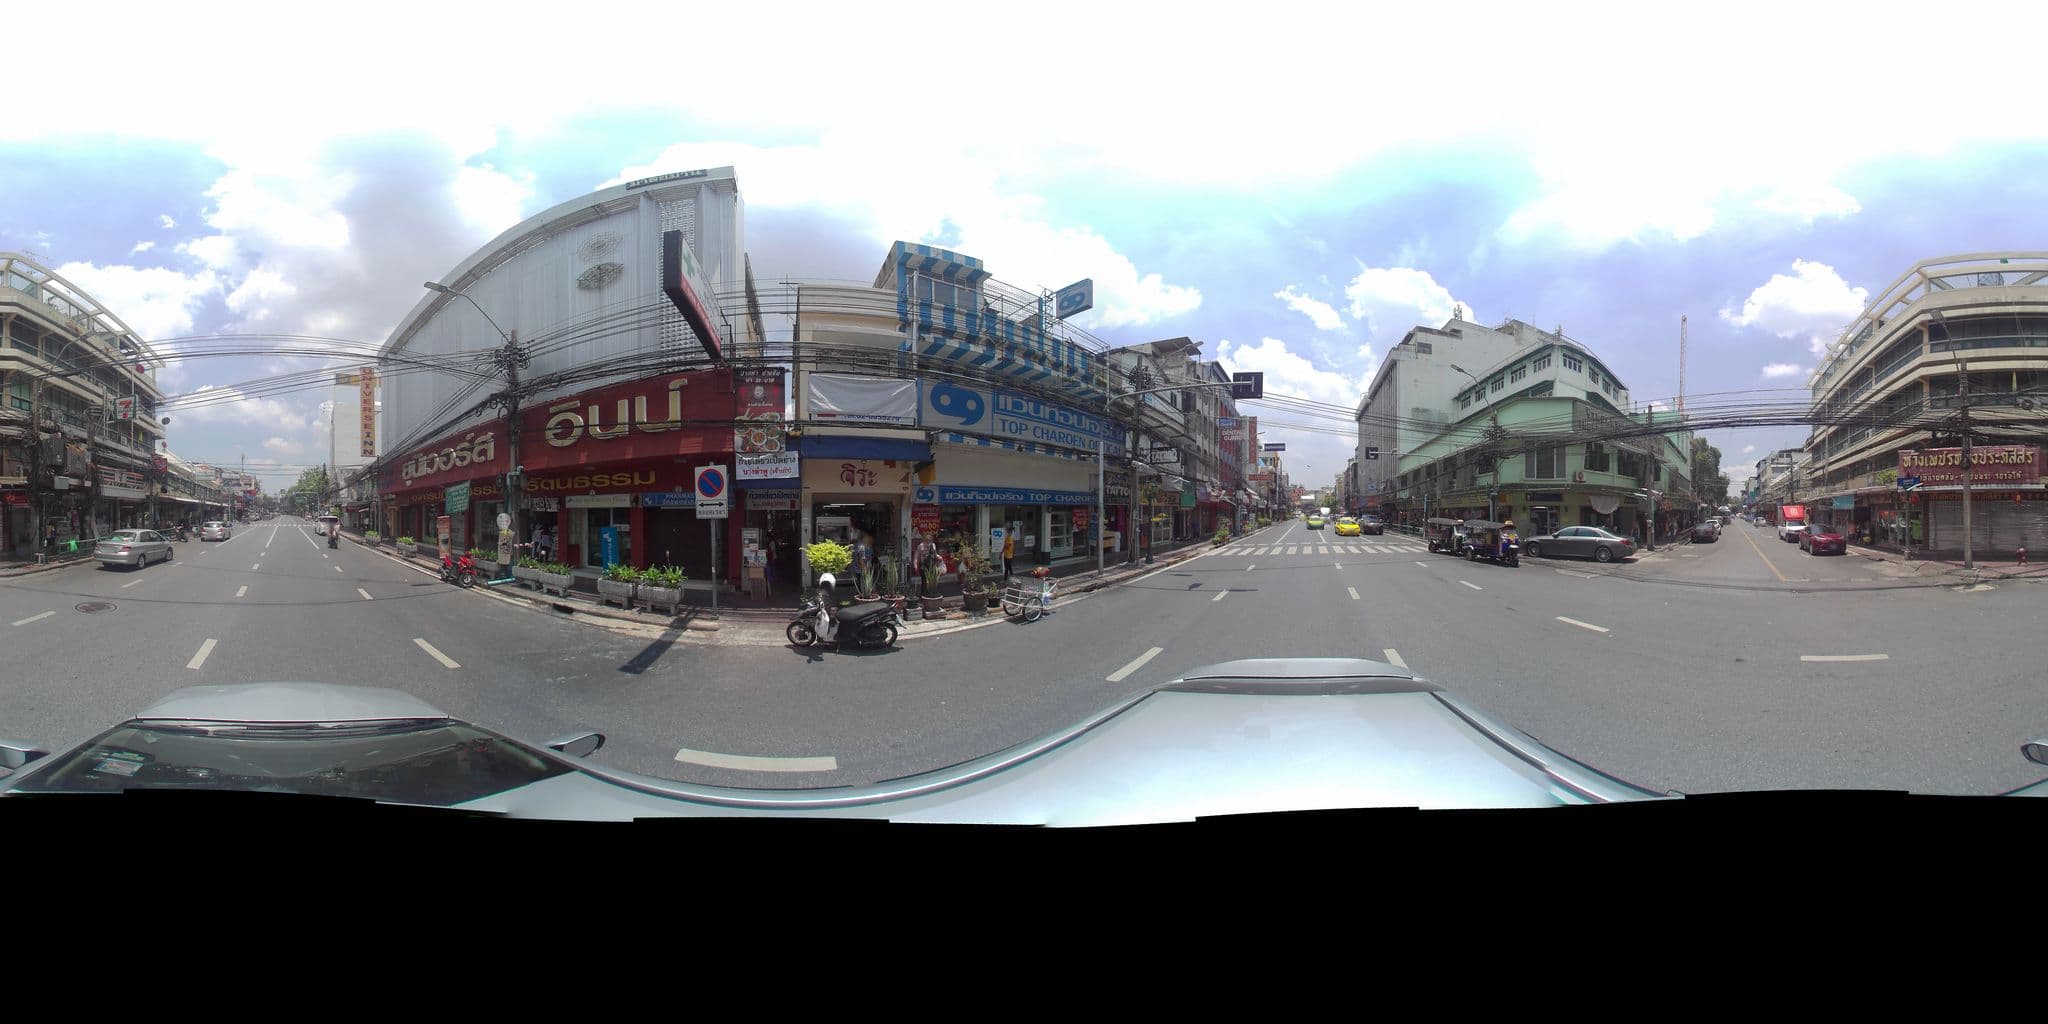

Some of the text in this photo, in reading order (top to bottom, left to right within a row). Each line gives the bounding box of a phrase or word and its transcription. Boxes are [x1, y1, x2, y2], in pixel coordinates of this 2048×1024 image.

[545, 379, 688, 447] อินน์
[1000, 419, 1028, 436] TOP
[1033, 425, 1086, 449] CHAROEN
[840, 463, 877, 487] จิระ
[1028, 493, 1051, 501] TOP
